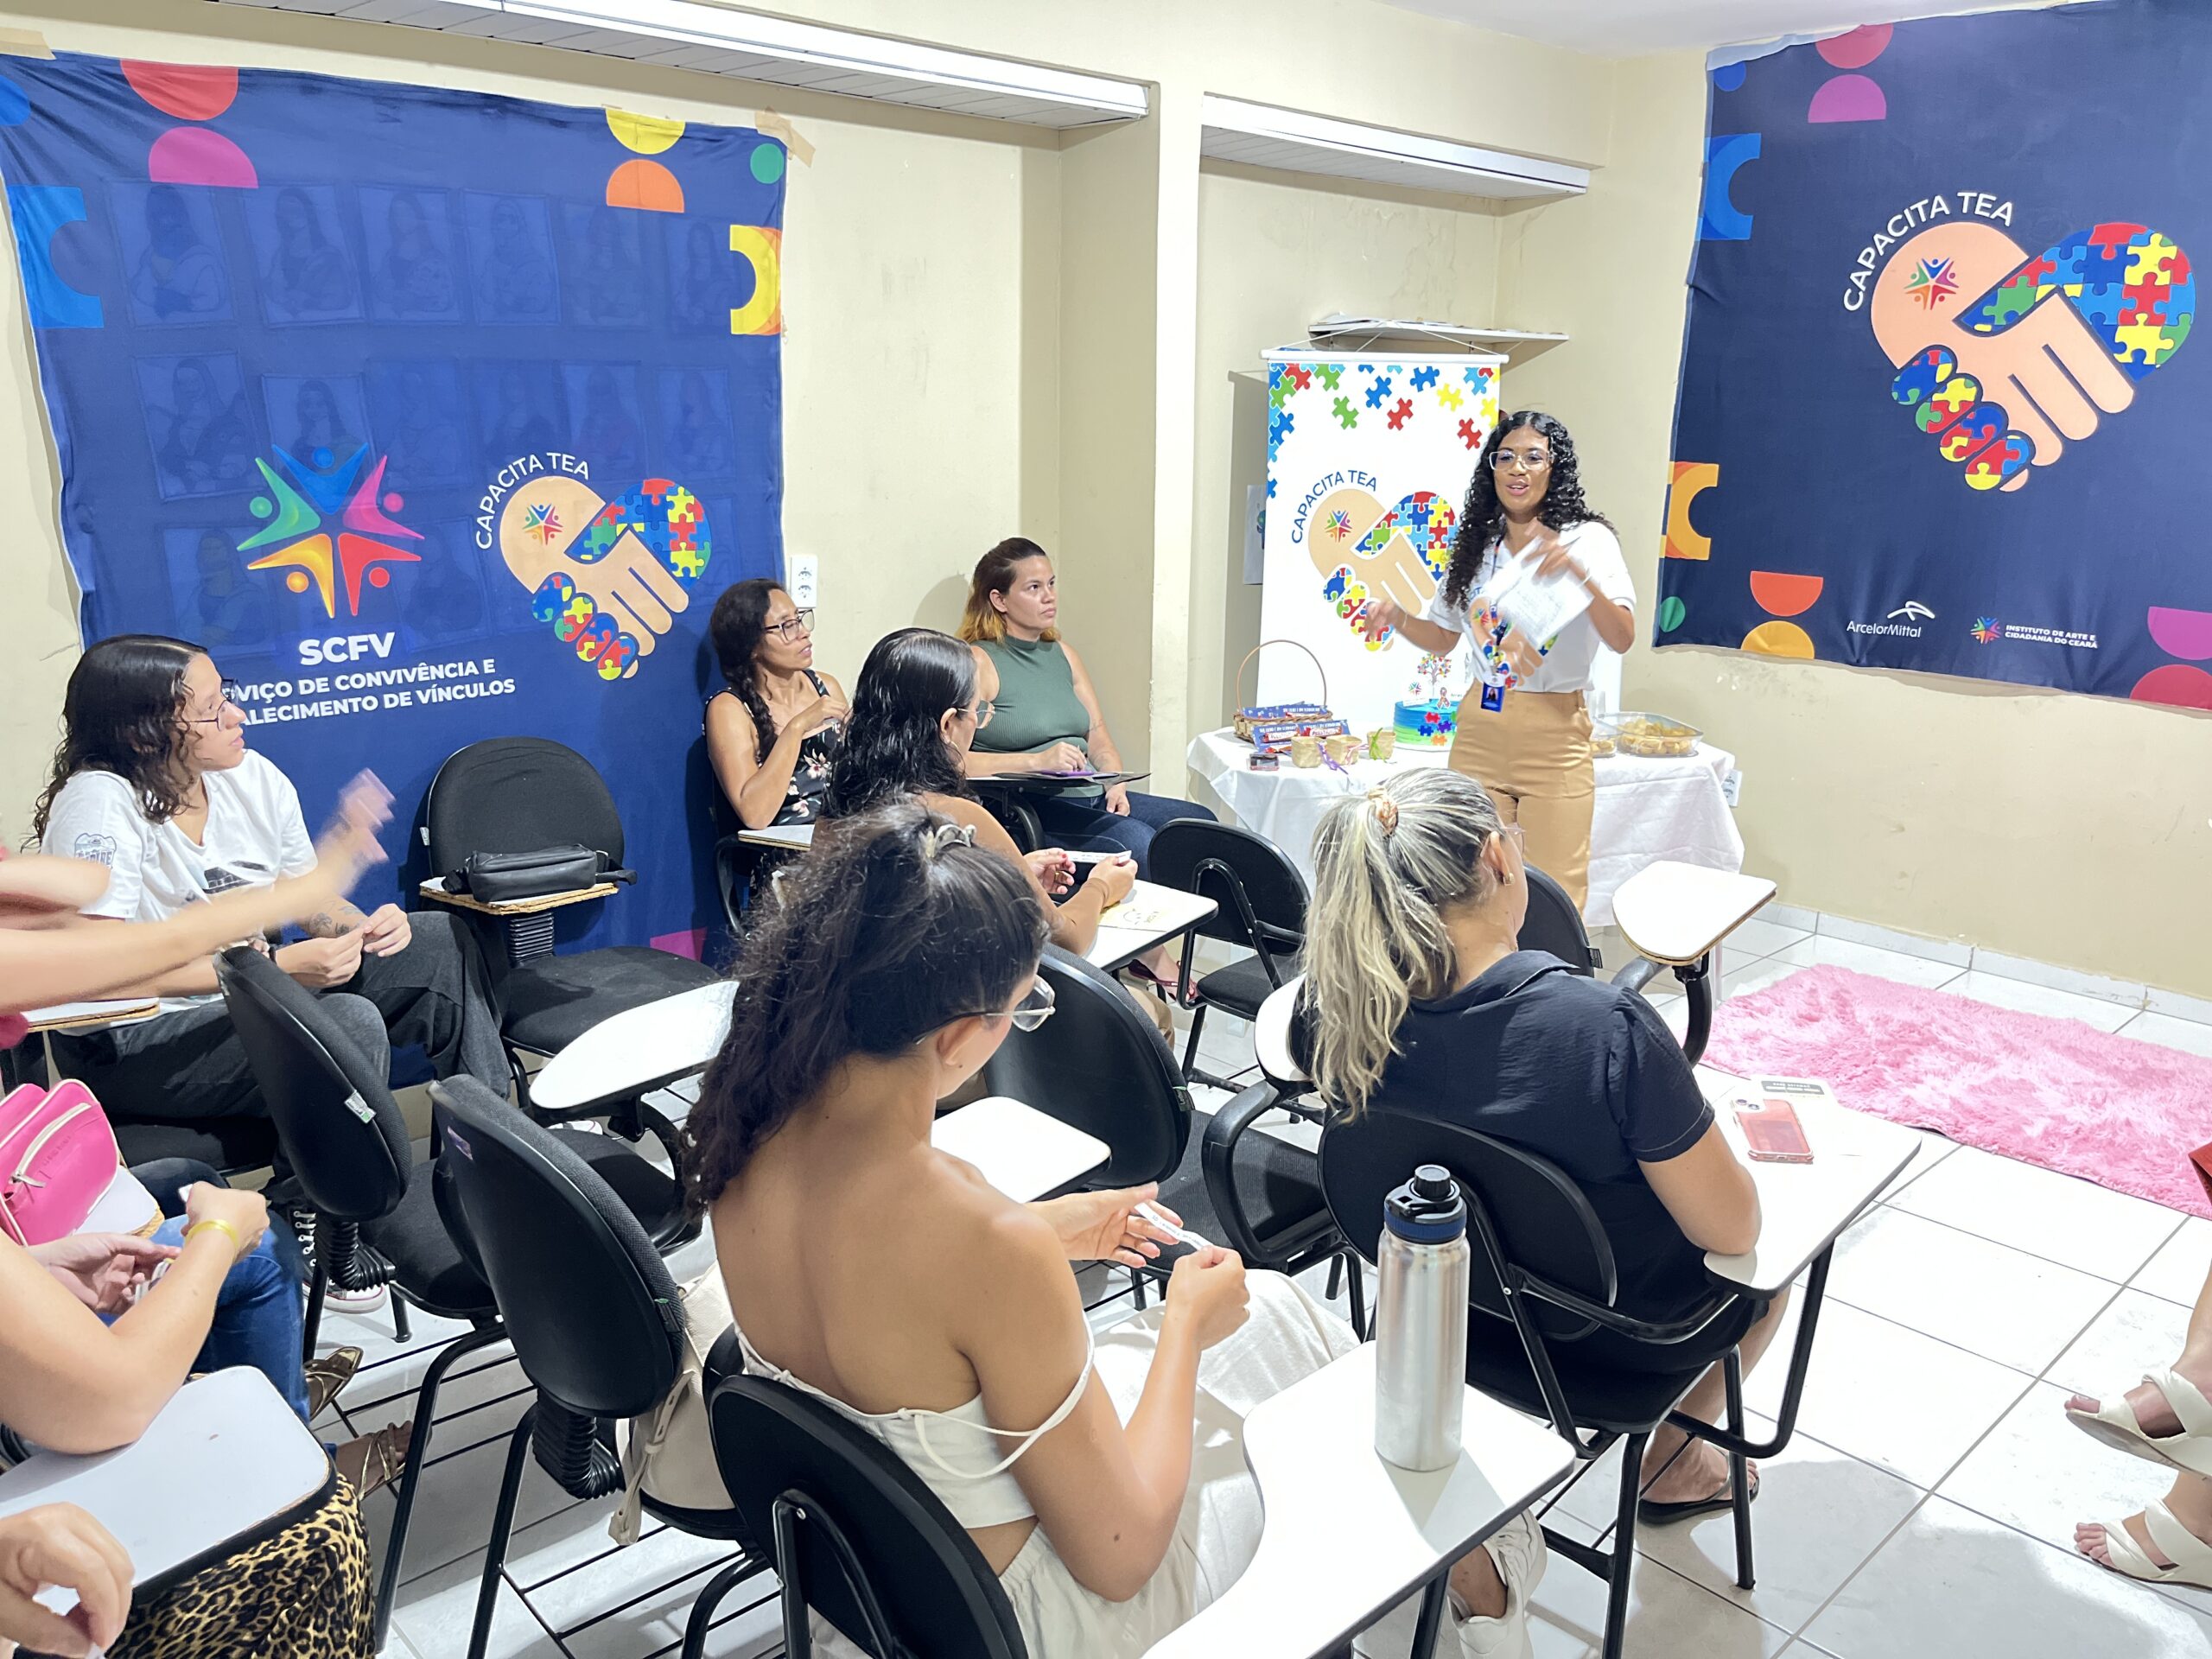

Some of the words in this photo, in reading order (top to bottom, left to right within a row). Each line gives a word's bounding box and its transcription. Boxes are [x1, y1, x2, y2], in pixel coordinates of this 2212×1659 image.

[1843, 195, 1950, 311] CAPACITA
[1957, 192, 2012, 226] TEA
[476, 454, 544, 549] CAPACITA
[546, 452, 588, 480] TEA
[1292, 471, 1344, 543] CAPACITA
[1348, 470, 1376, 492] TEA
[298, 632, 395, 665] SCFV
[1847, 620, 1922, 638] ArcelorMittal
[2005, 625, 2050, 635] INSTITUTO
[2065, 632, 2088, 640] ARTE
[2005, 632, 2052, 643] CIDADANIA
[2069, 639, 2098, 649] CEARÁ
[222, 680, 293, 704] RVIÇO
[298, 677, 330, 696] DE
[334, 659, 480, 690] CONVIVÊNCIA
[483, 658, 496, 674] E
[241, 695, 378, 726] LECIMENTO
[384, 690, 413, 709] DE
[414, 678, 516, 704] VÍNCULOS
